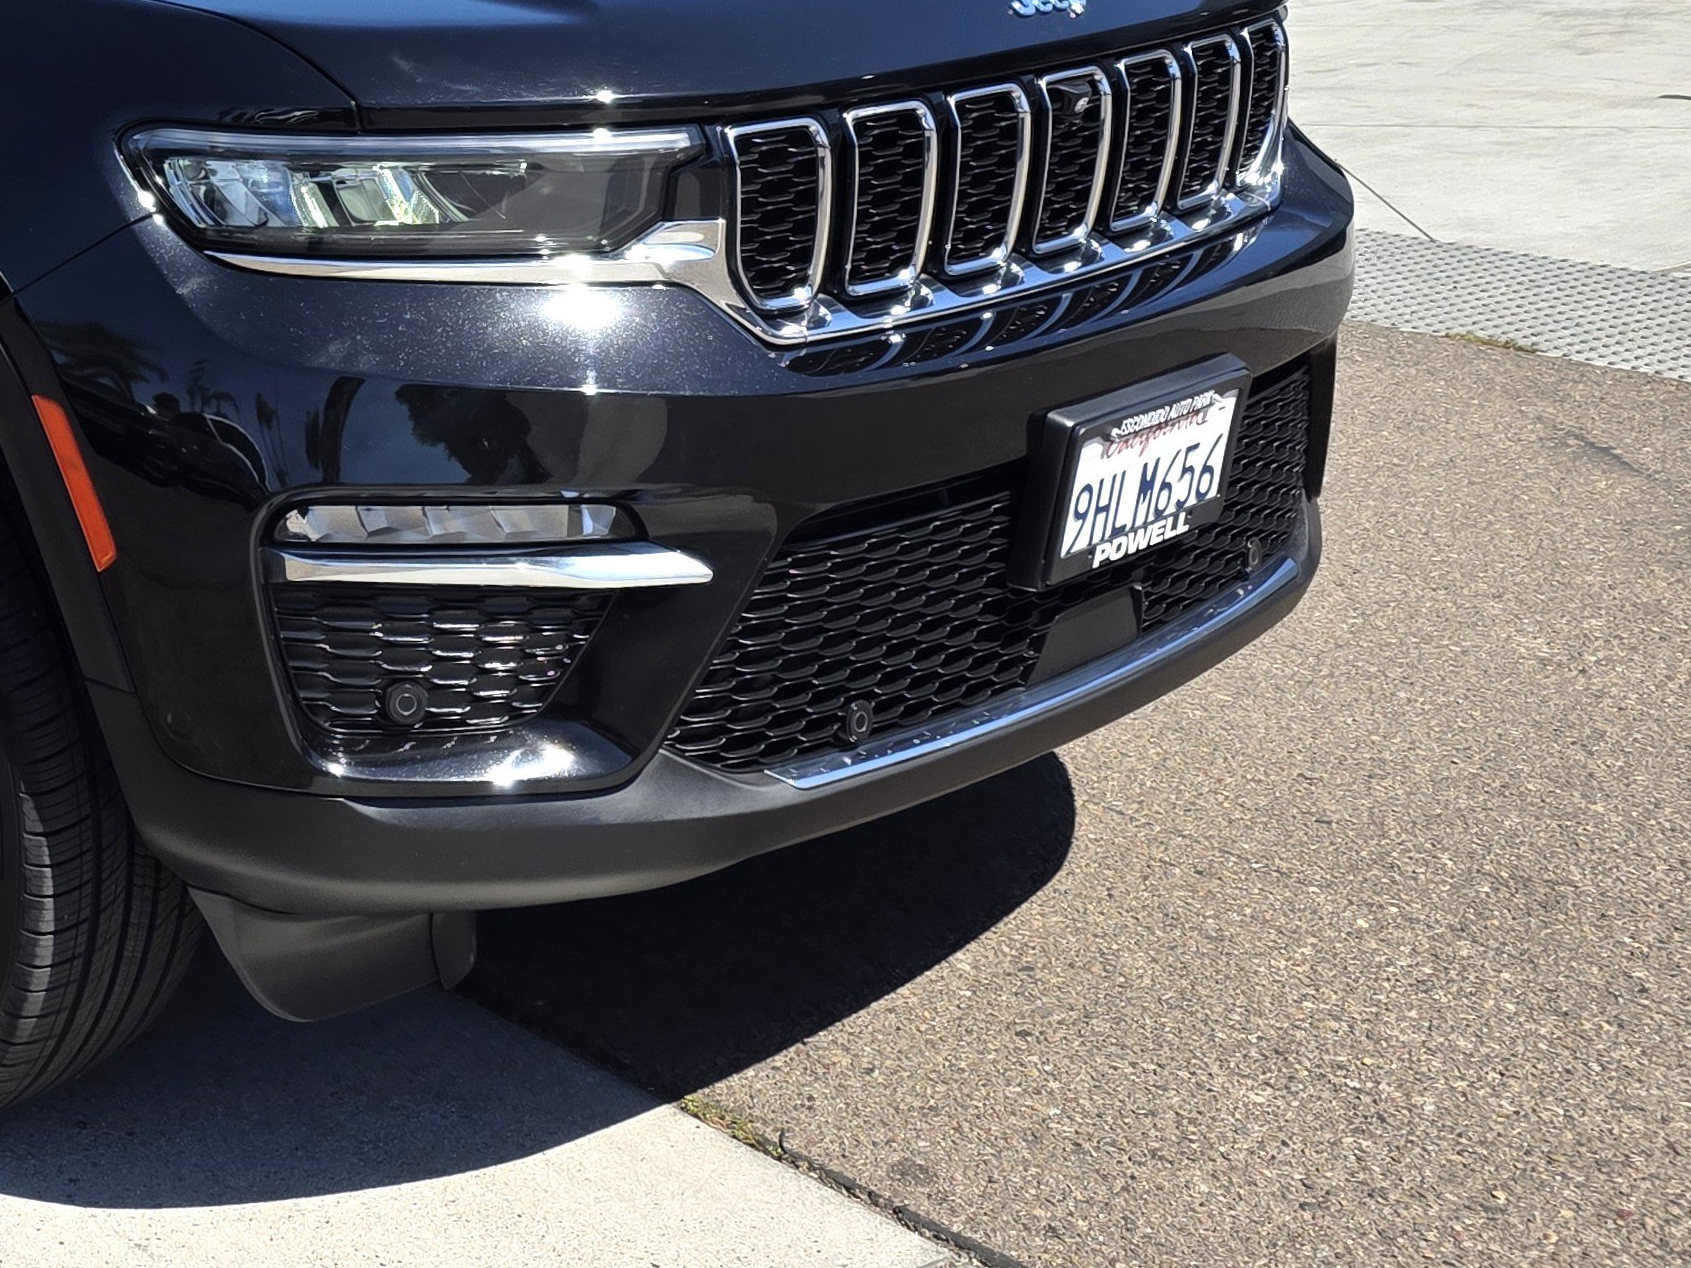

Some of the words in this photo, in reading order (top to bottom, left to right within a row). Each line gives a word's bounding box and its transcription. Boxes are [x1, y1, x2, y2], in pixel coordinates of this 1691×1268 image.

[1120, 405, 1171, 436] ESCONDIDO
[1168, 398, 1193, 422] AUTO
[1067, 432, 1224, 554] 9HLM656
[1091, 511, 1191, 569] POWELL
